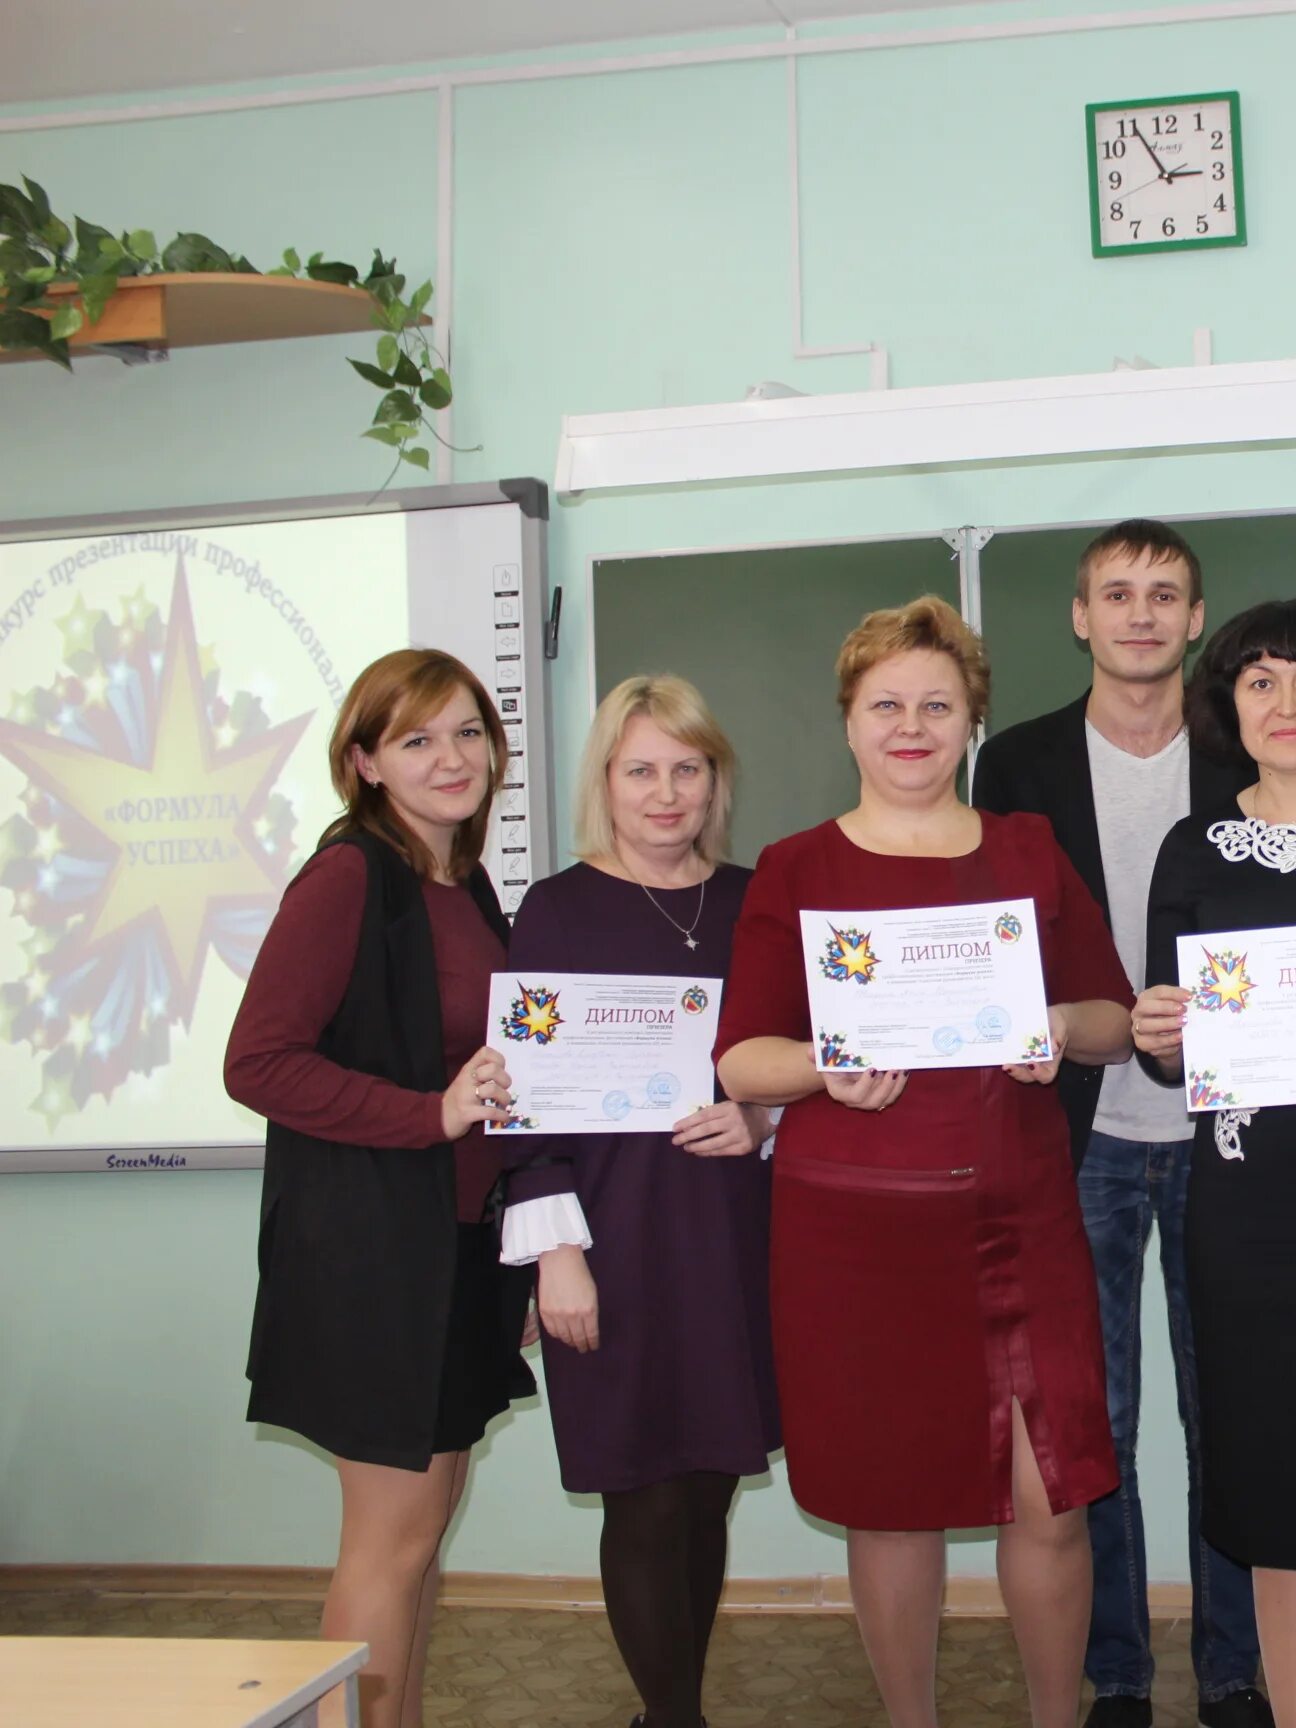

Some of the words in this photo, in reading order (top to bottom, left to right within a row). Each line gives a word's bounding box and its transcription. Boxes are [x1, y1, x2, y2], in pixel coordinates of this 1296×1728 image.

[1116, 118, 1139, 138] 11
[1152, 114, 1178, 136] 12
[1193, 112, 1205, 131] 1
[1102, 139, 1126, 159] 10
[1210, 131, 1223, 150] 2
[1108, 171, 1122, 190] 9
[1212, 162, 1225, 181] 3
[1110, 201, 1123, 221] 8
[1213, 192, 1227, 212] 4
[1129, 220, 1142, 239] 7
[1162, 217, 1175, 236] 6
[1196, 214, 1209, 234] 5
[47, 531, 198, 587] презентации
[901, 941, 992, 964] ДИПЛОМ
[585, 1008, 675, 1026] ДИПЛОМ
[106, 1152, 186, 1169] ScreenMedia
